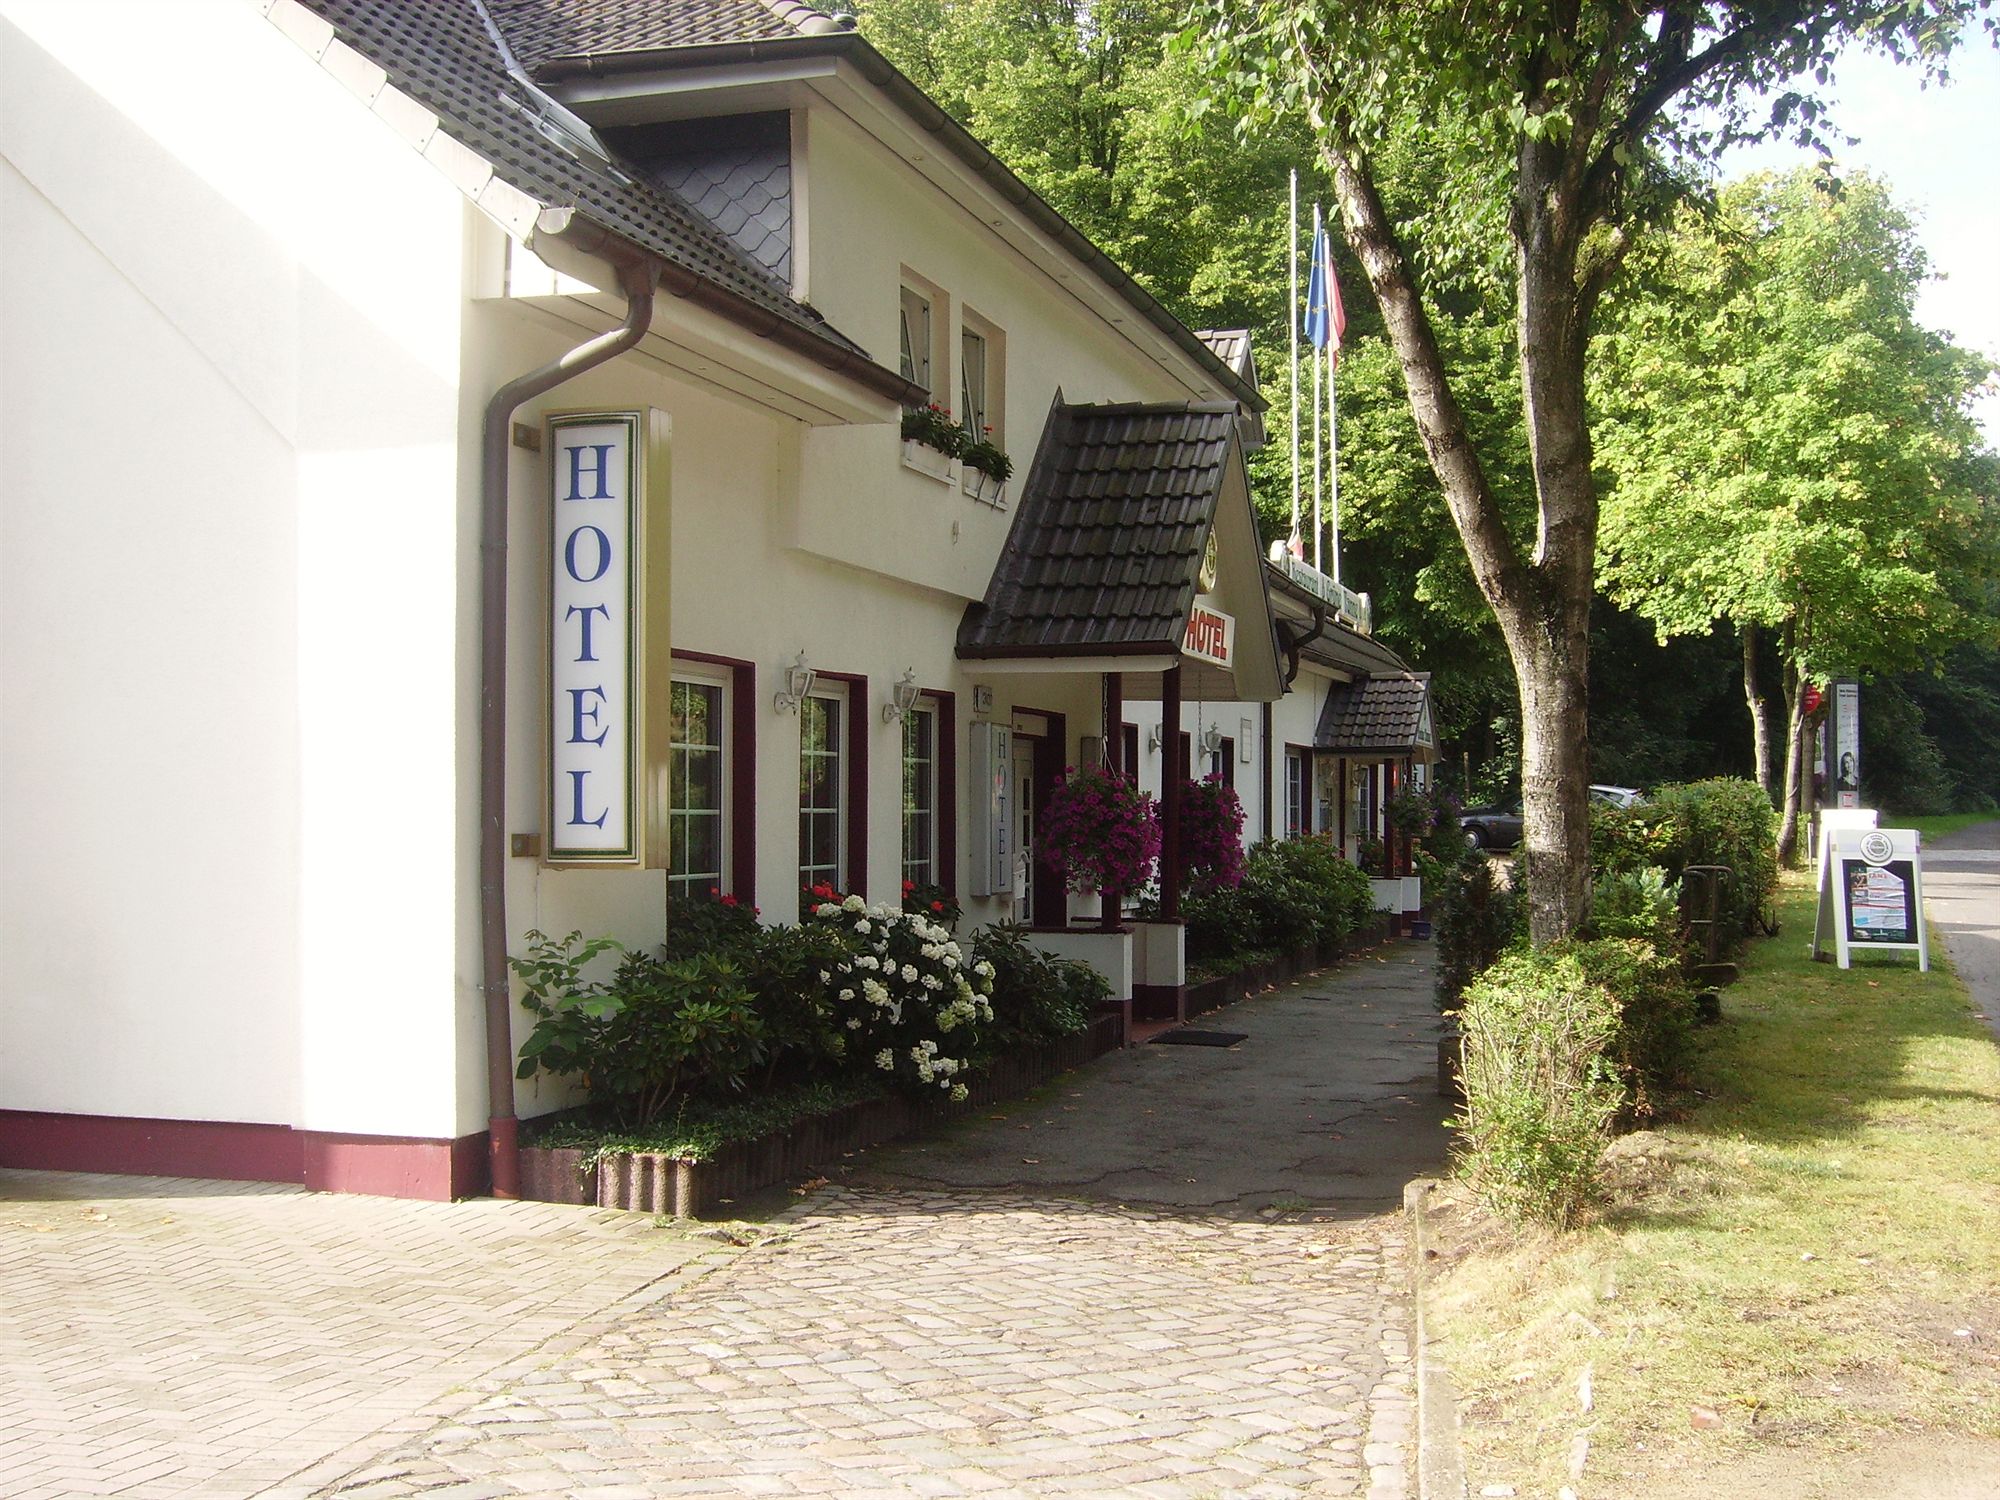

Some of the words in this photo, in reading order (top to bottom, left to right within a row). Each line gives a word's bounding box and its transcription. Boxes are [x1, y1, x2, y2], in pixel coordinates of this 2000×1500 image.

[563, 444, 616, 830] HOTEL
[1186, 608, 1227, 660] HOTEL
[997, 732, 1006, 887] HOTEL
